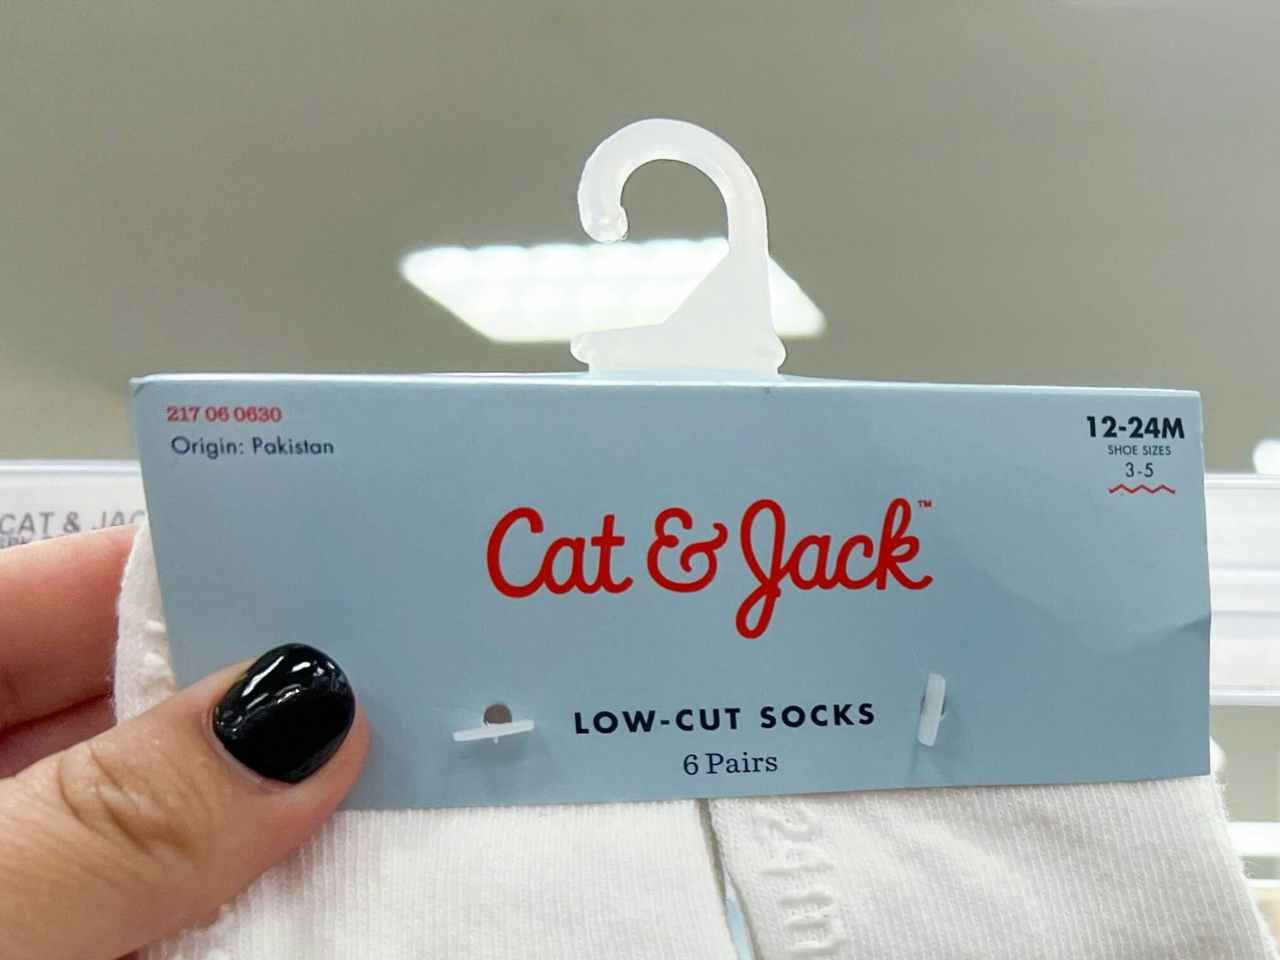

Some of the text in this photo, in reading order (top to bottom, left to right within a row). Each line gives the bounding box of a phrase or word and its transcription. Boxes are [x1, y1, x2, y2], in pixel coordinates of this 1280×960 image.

[167, 405, 283, 423] 217 06 0630
[1086, 415, 1185, 440] 12-24M
[171, 435, 334, 460] Origin: Pakistan
[1107, 444, 1172, 456] SHOE SIZES
[63, 510, 81, 533] &
[486, 506, 634, 598] Cat
[646, 506, 729, 593] &
[735, 497, 934, 639] Jack
[573, 702, 876, 735] LOW-CUT SOCKS
[682, 751, 779, 775] 6 Pairs
